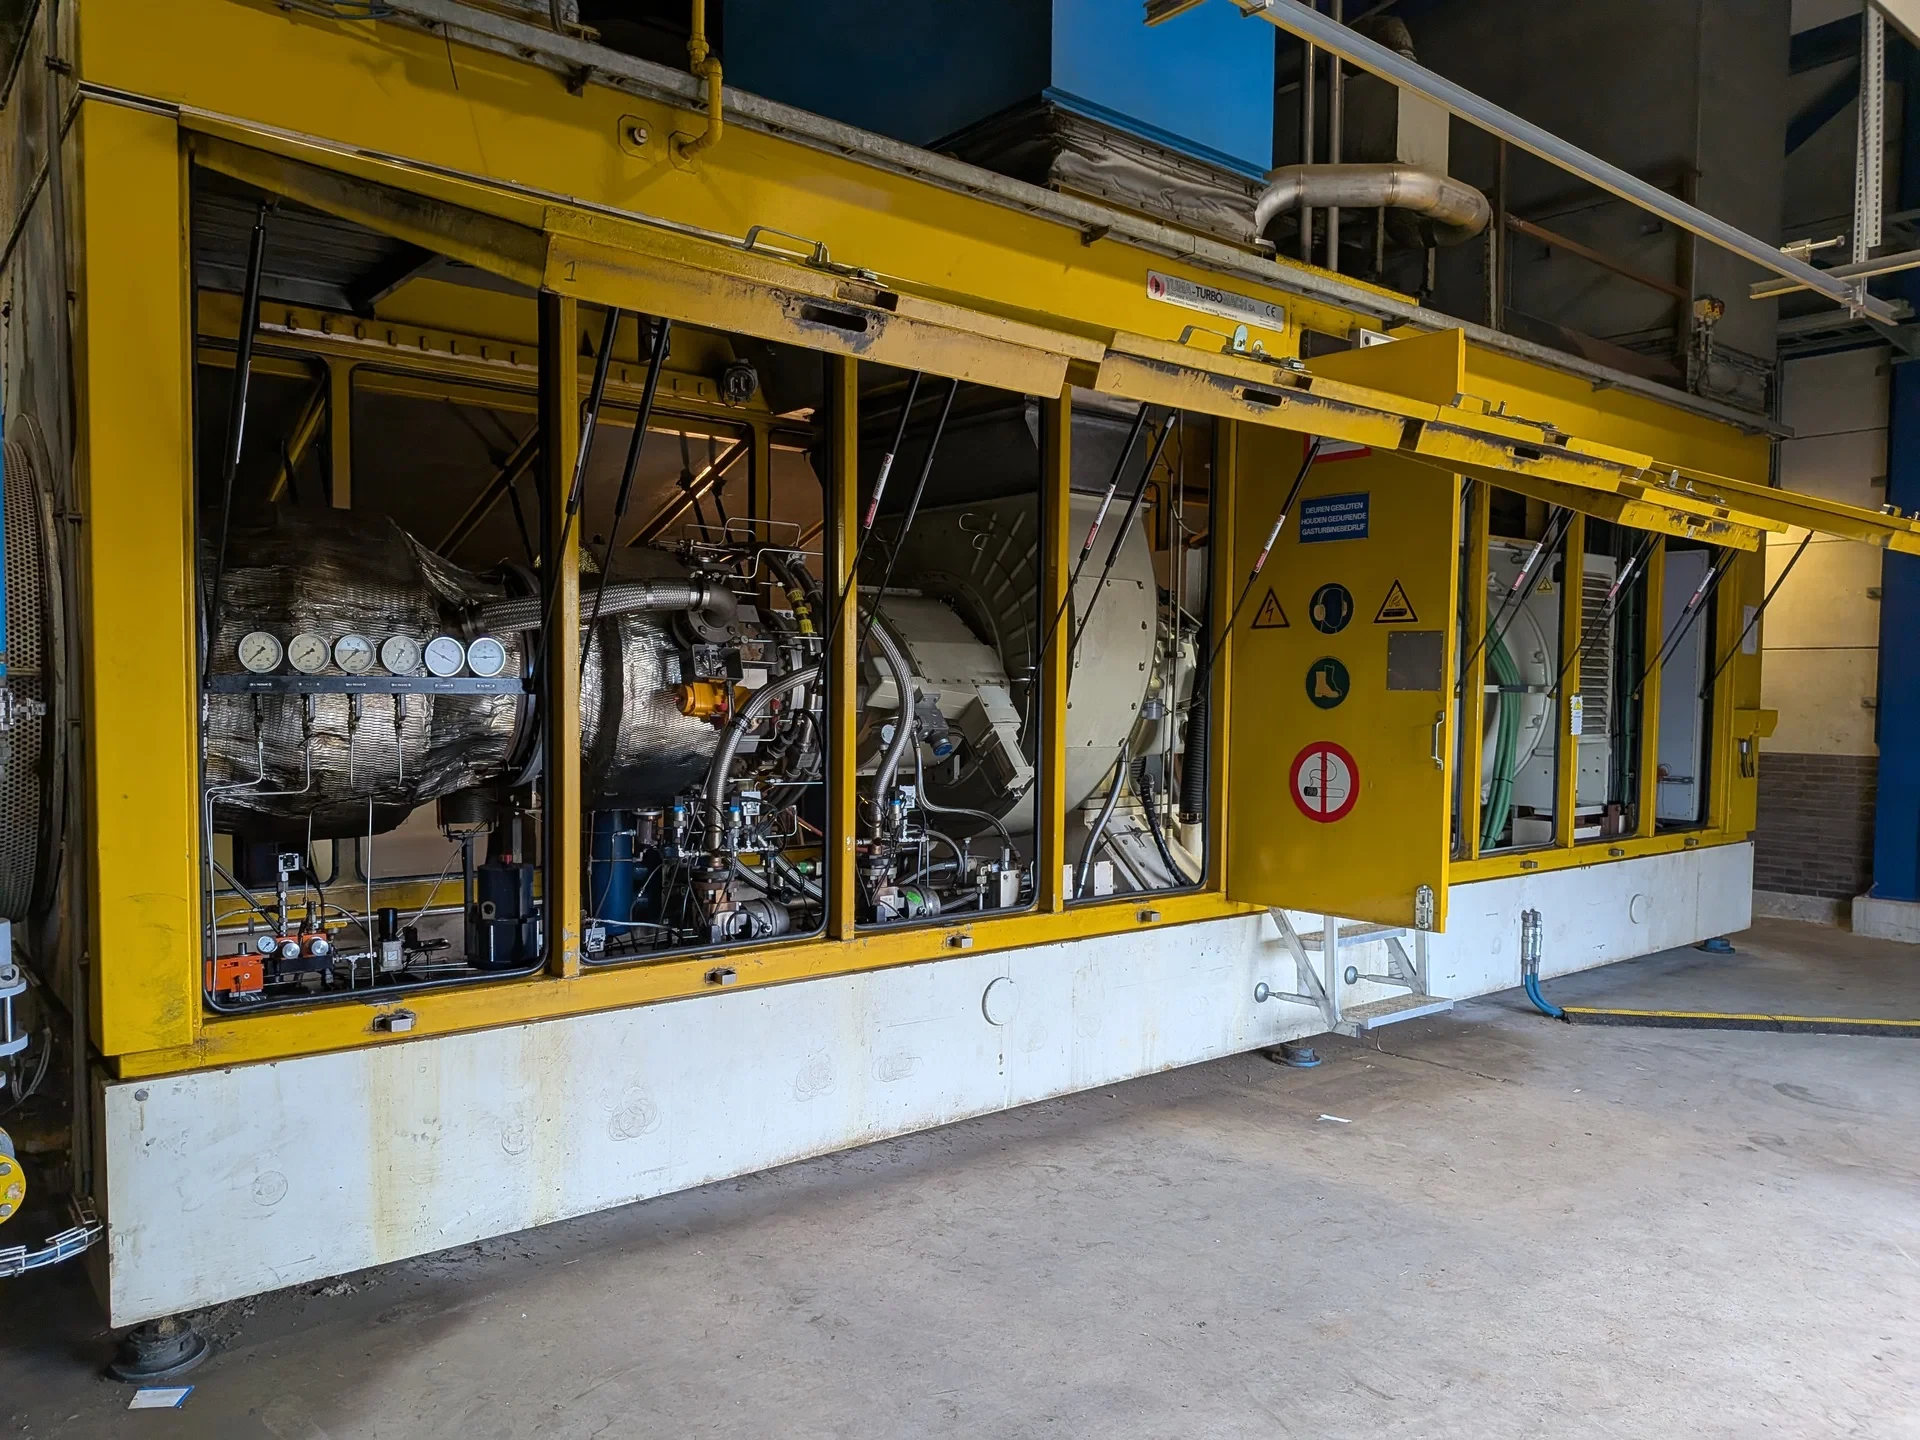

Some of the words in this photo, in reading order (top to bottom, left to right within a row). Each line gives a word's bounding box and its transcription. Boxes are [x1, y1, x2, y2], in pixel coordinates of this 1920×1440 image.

[1306, 505, 1330, 514] DEUREN
[1331, 502, 1364, 512] GESLOTEN
[1301, 516, 1327, 525] HOUDEN
[1328, 513, 1367, 523] GEDURENDE
